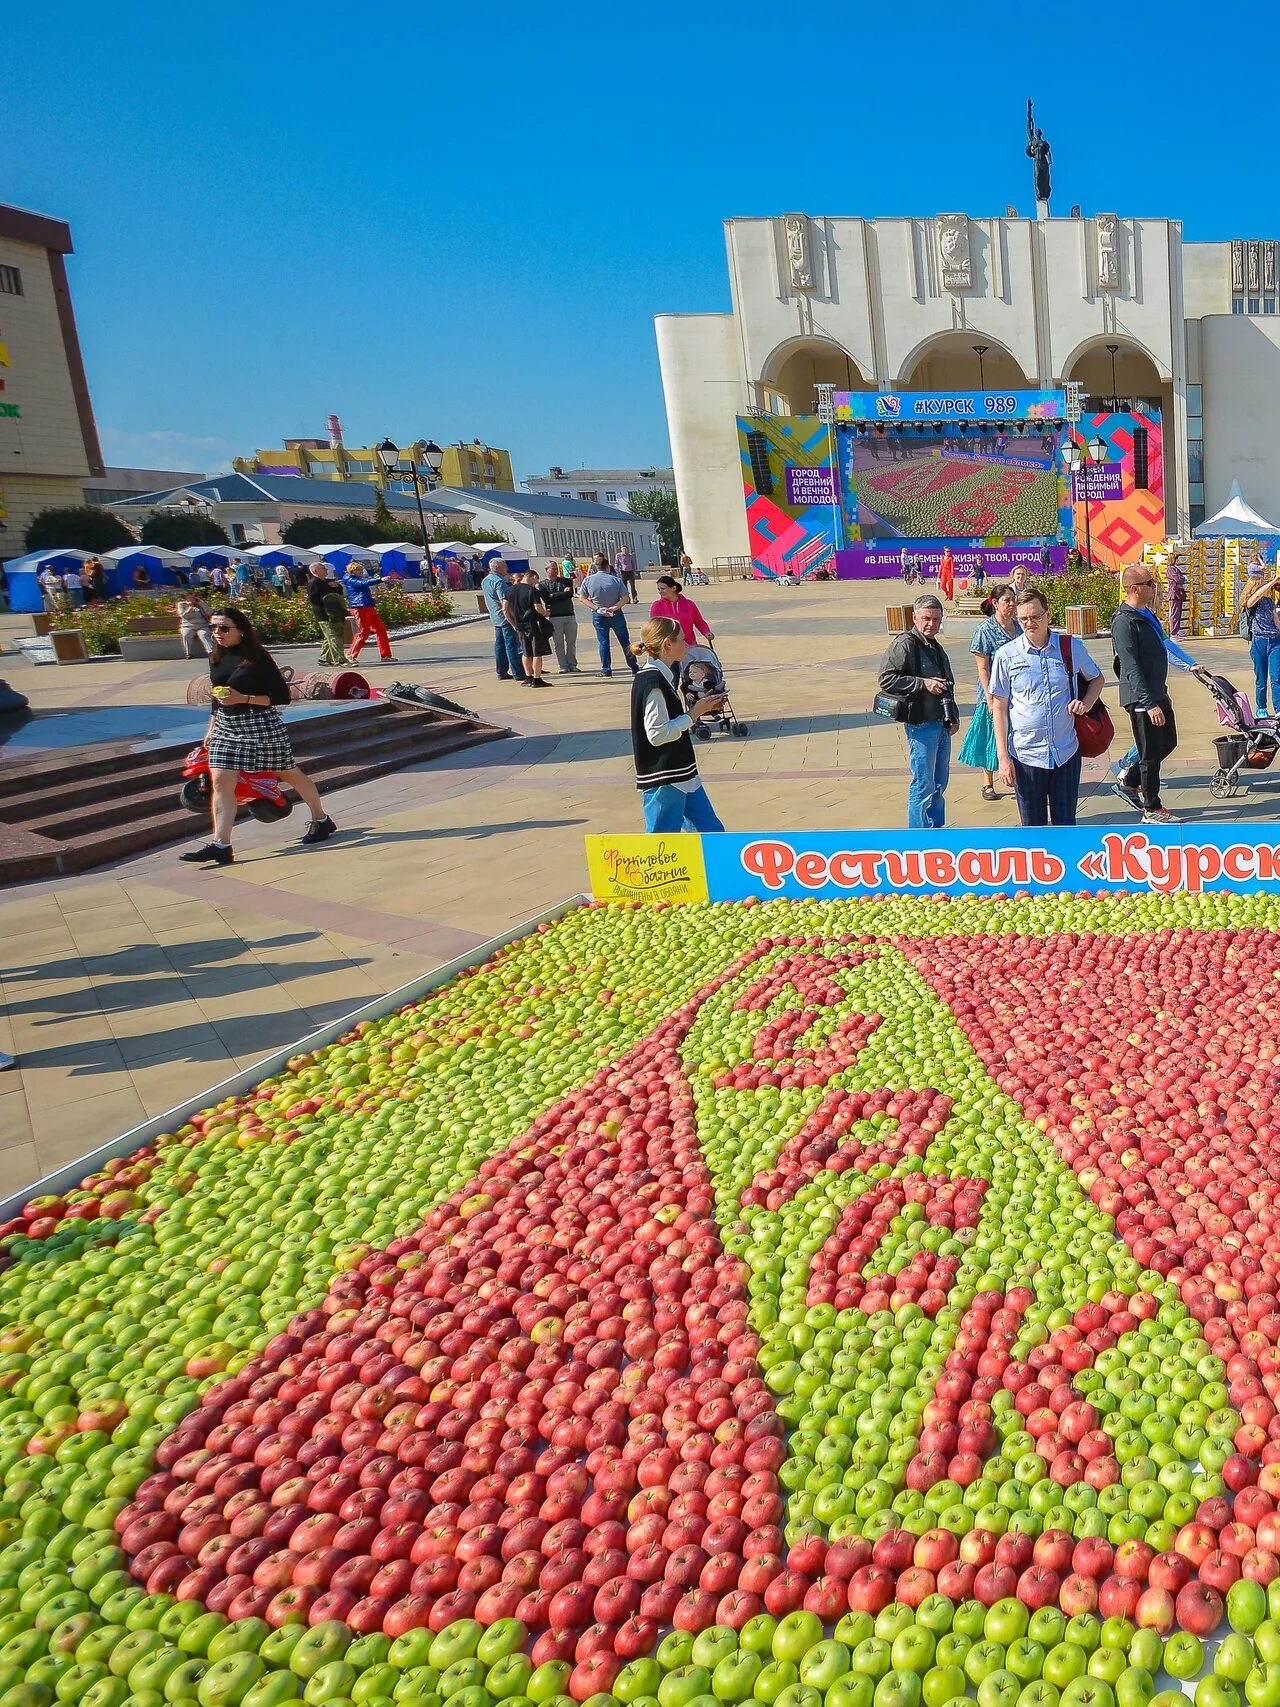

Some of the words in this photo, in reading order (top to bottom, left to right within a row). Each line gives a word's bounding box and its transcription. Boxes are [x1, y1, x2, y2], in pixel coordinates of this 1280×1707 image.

[915, 399, 974, 414] #КУРСК
[984, 396, 1017, 414] 989
[791, 469, 820, 479] ГОРОД
[792, 477, 833, 487] ДРЕВНИЙ
[793, 487, 800, 495] И
[801, 486, 830, 495] ВЕЧНО
[878, 555, 901, 564] ЛЕНТ
[985, 553, 1011, 562] ТВОЯ,
[604, 842, 678, 876] Фруктовое
[741, 841, 1065, 889] Фестиваль
[660, 883, 689, 899] ОБОЯНИ
